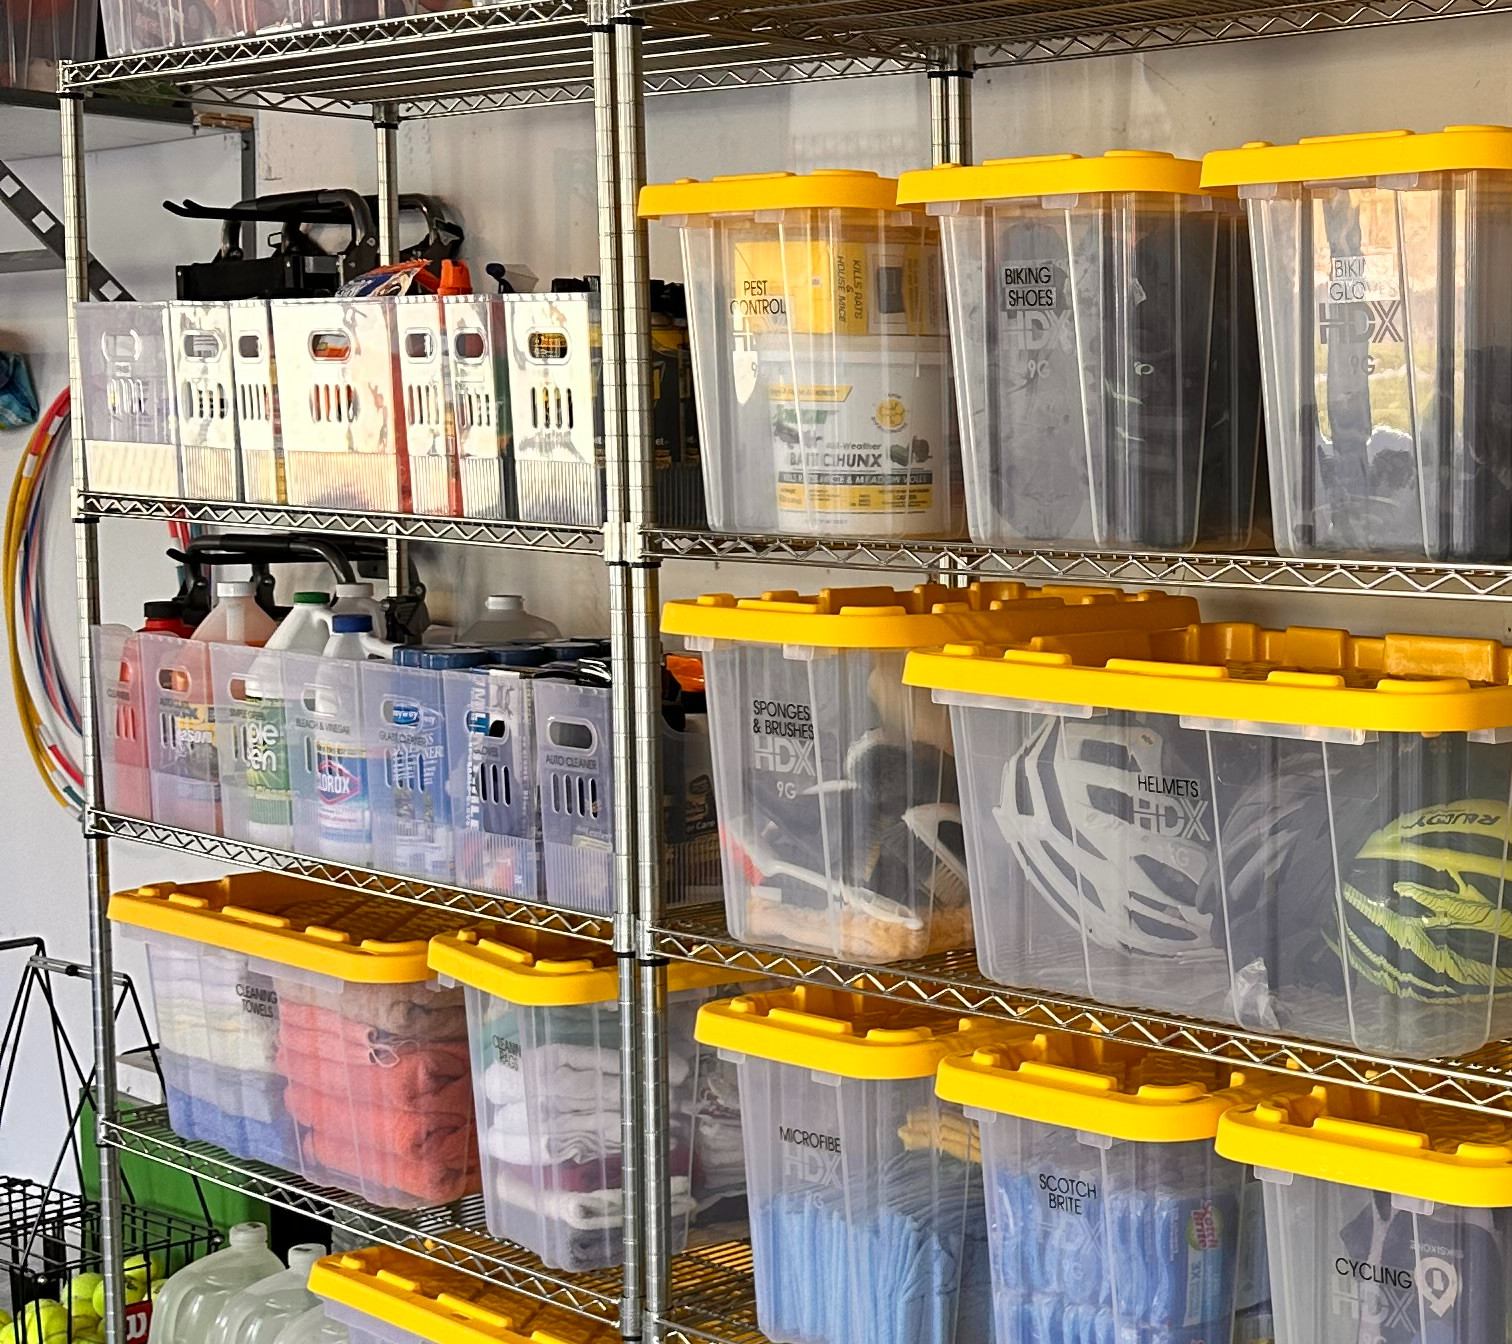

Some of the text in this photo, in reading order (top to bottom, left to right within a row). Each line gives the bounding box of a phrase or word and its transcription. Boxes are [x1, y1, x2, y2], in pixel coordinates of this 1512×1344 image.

[1004, 267, 1052, 285] BIKING
[744, 280, 768, 296] PEST
[1008, 289, 1054, 308] SHOES
[730, 298, 787, 316] CONTROL
[1001, 310, 1071, 351] HDX
[1319, 300, 1404, 344] HDX
[1026, 359, 1051, 379] 9G
[753, 700, 811, 721] SPONGES
[753, 719, 815, 740] & BRUSHES
[546, 756, 596, 770] AUTO CLEANER
[753, 737, 817, 776] HDX
[776, 781, 797, 800] 9G
[1137, 775, 1199, 798] HELMETS
[1133, 797, 1210, 842] HDX
[235, 982, 278, 1005] CLEANING
[240, 997, 274, 1020] TOWELS
[1038, 1172, 1097, 1201] SCOTCH
[1049, 1192, 1083, 1216] BRITE
[1335, 1257, 1412, 1289] CYCLING
[1331, 1274, 1417, 1334] HDX
